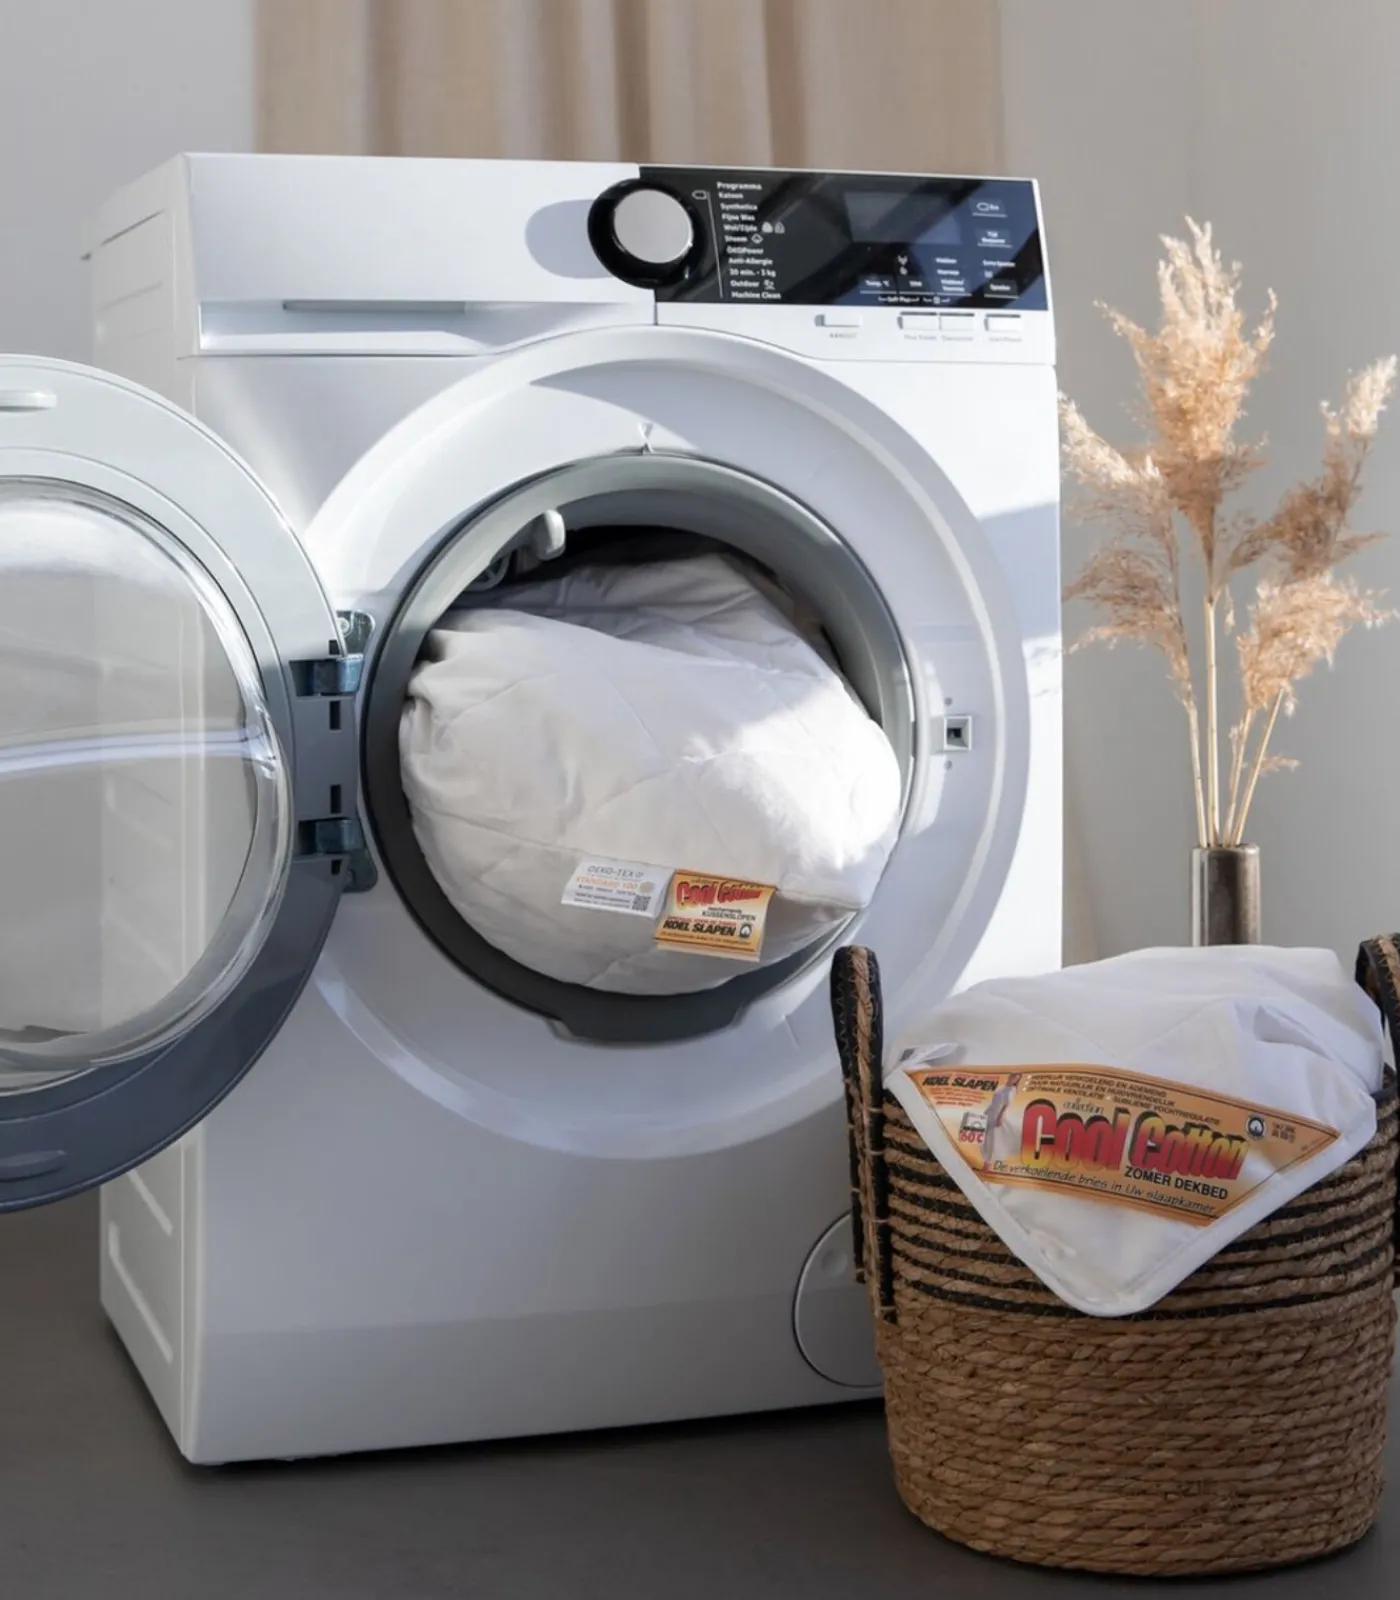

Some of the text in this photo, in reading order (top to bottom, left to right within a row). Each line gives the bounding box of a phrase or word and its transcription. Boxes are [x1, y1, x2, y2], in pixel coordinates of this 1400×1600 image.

[762, 291, 781, 299] Clean
[676, 880, 718, 908] Cool
[663, 920, 737, 936] KOEL SLAPEN
[923, 1075, 949, 1086] KOEL
[951, 1076, 999, 1091] SLAPEN
[1116, 1081, 1127, 1089] EN
[1021, 1098, 1249, 1180] Cool Cotton
[993, 1159, 1216, 1214] De verkoelende bries in Uw slaapkamer
[1125, 1165, 1228, 1200] ZOMER DEKBED
